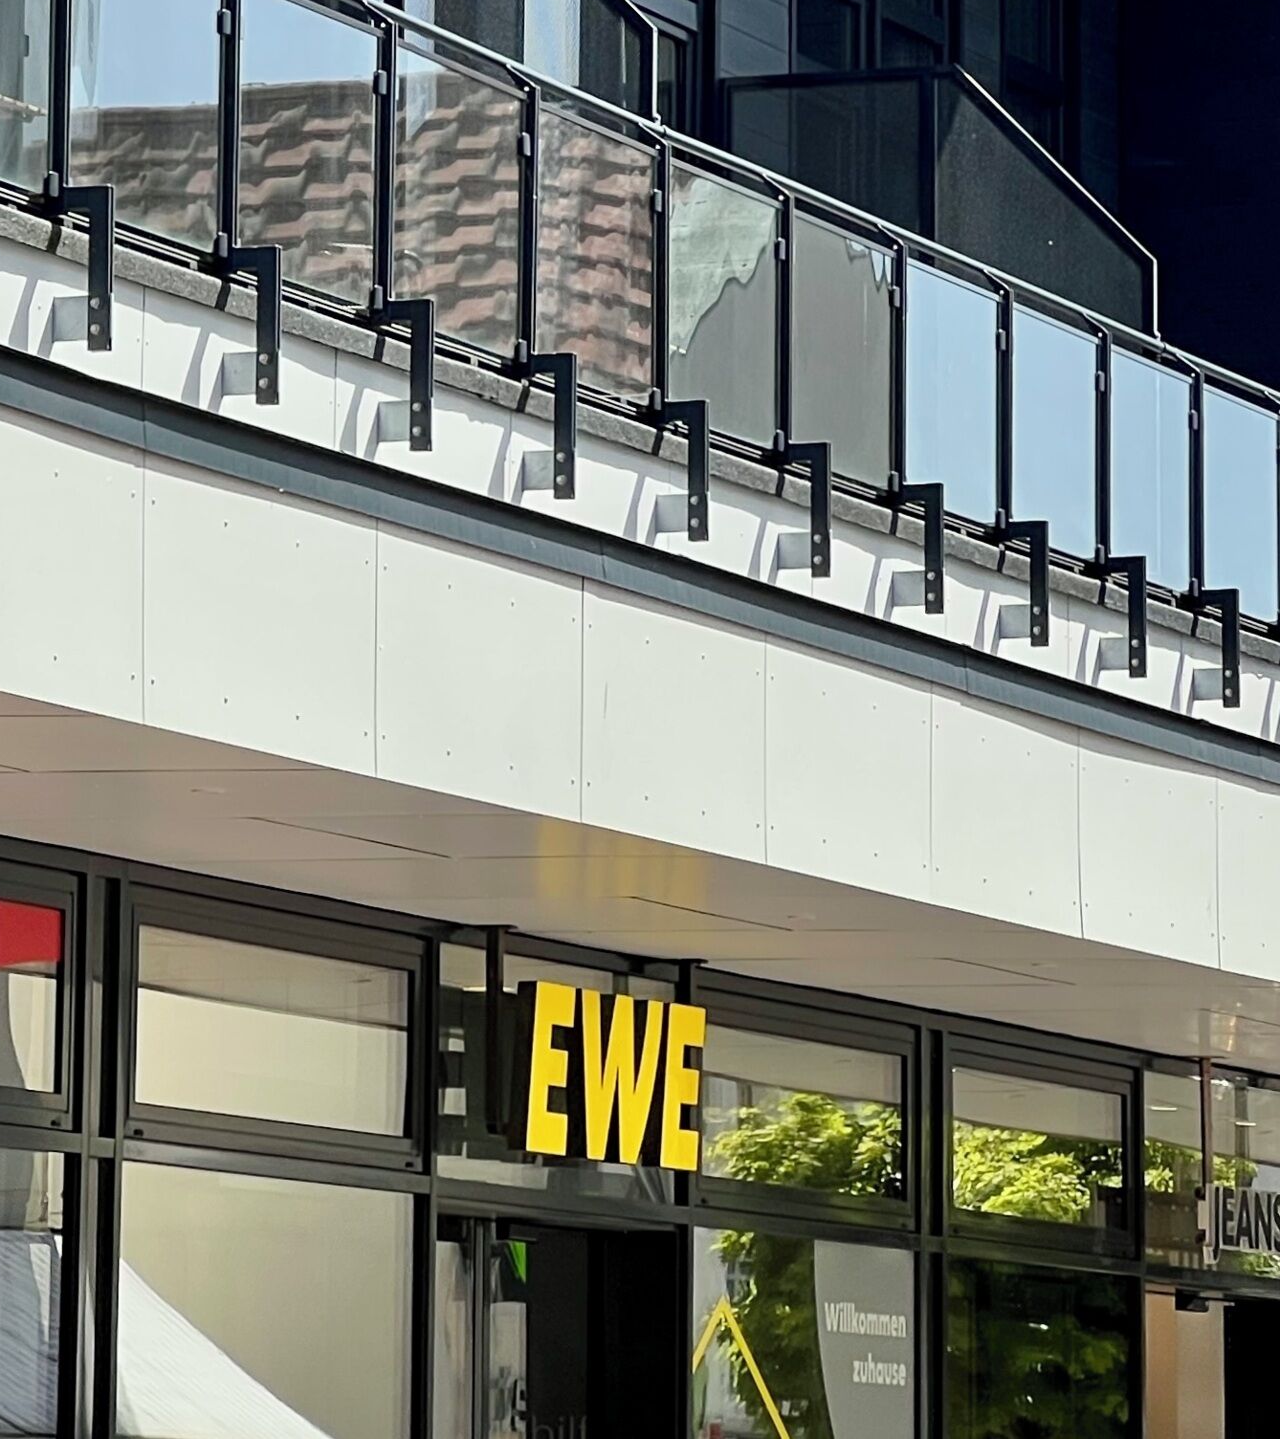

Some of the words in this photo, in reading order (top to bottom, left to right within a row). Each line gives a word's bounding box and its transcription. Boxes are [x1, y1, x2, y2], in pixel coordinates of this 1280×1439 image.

[525, 980, 706, 1171] EWE
[824, 1301, 907, 1338] Willkommen
[852, 1352, 907, 1387] zuhause
